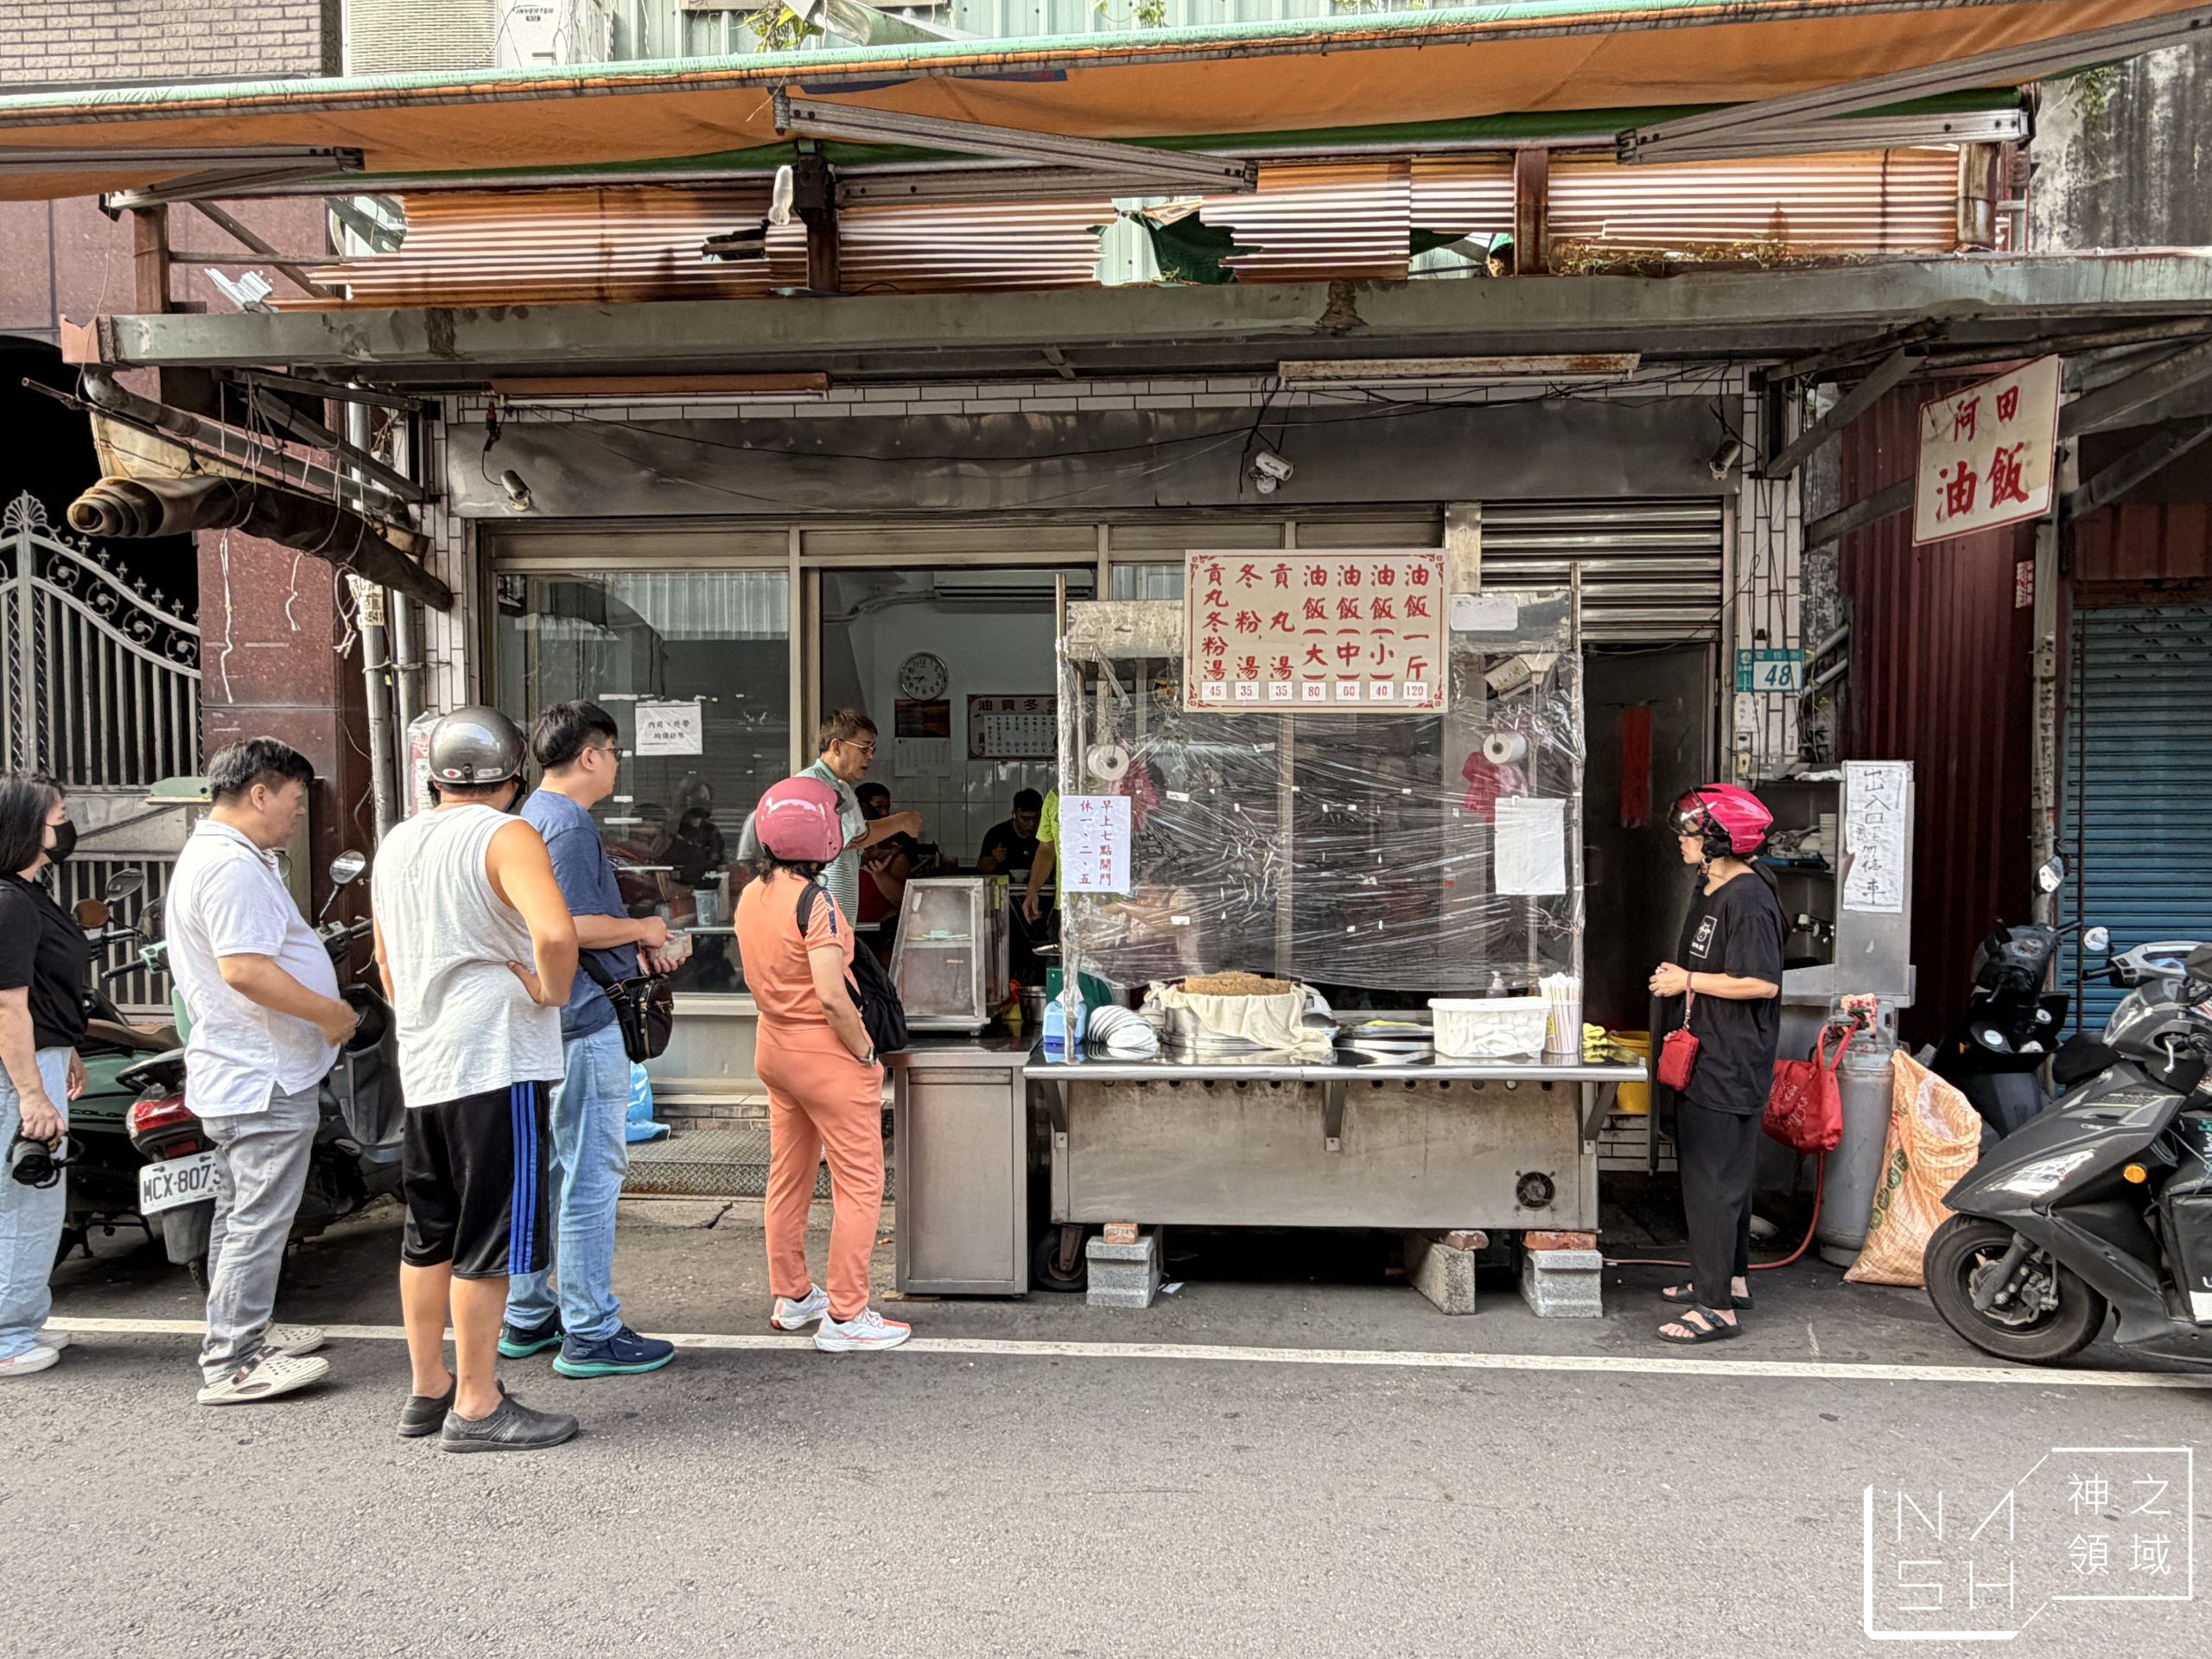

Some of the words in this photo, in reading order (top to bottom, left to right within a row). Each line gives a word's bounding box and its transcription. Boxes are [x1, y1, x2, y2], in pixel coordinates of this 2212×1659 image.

[1936, 442, 2029, 522] 油飯
[1201, 563, 1230, 681] 貢丸冬粉湯
[1234, 563, 1263, 681] 冬粉湯
[1268, 563, 1296, 681] 貢丸湯
[1403, 563, 1431, 682] 油飯一斤
[1210, 685, 1222, 696] 45
[1240, 685, 1253, 696] 35
[1275, 685, 1288, 696] 35
[1307, 685, 1320, 697] 80
[1376, 685, 1388, 696] 40
[1407, 685, 1424, 696] 120
[1764, 664, 1792, 686] 48
[1078, 799, 1094, 885] 休一、二、五
[1098, 799, 1114, 887] 早上七點開門
